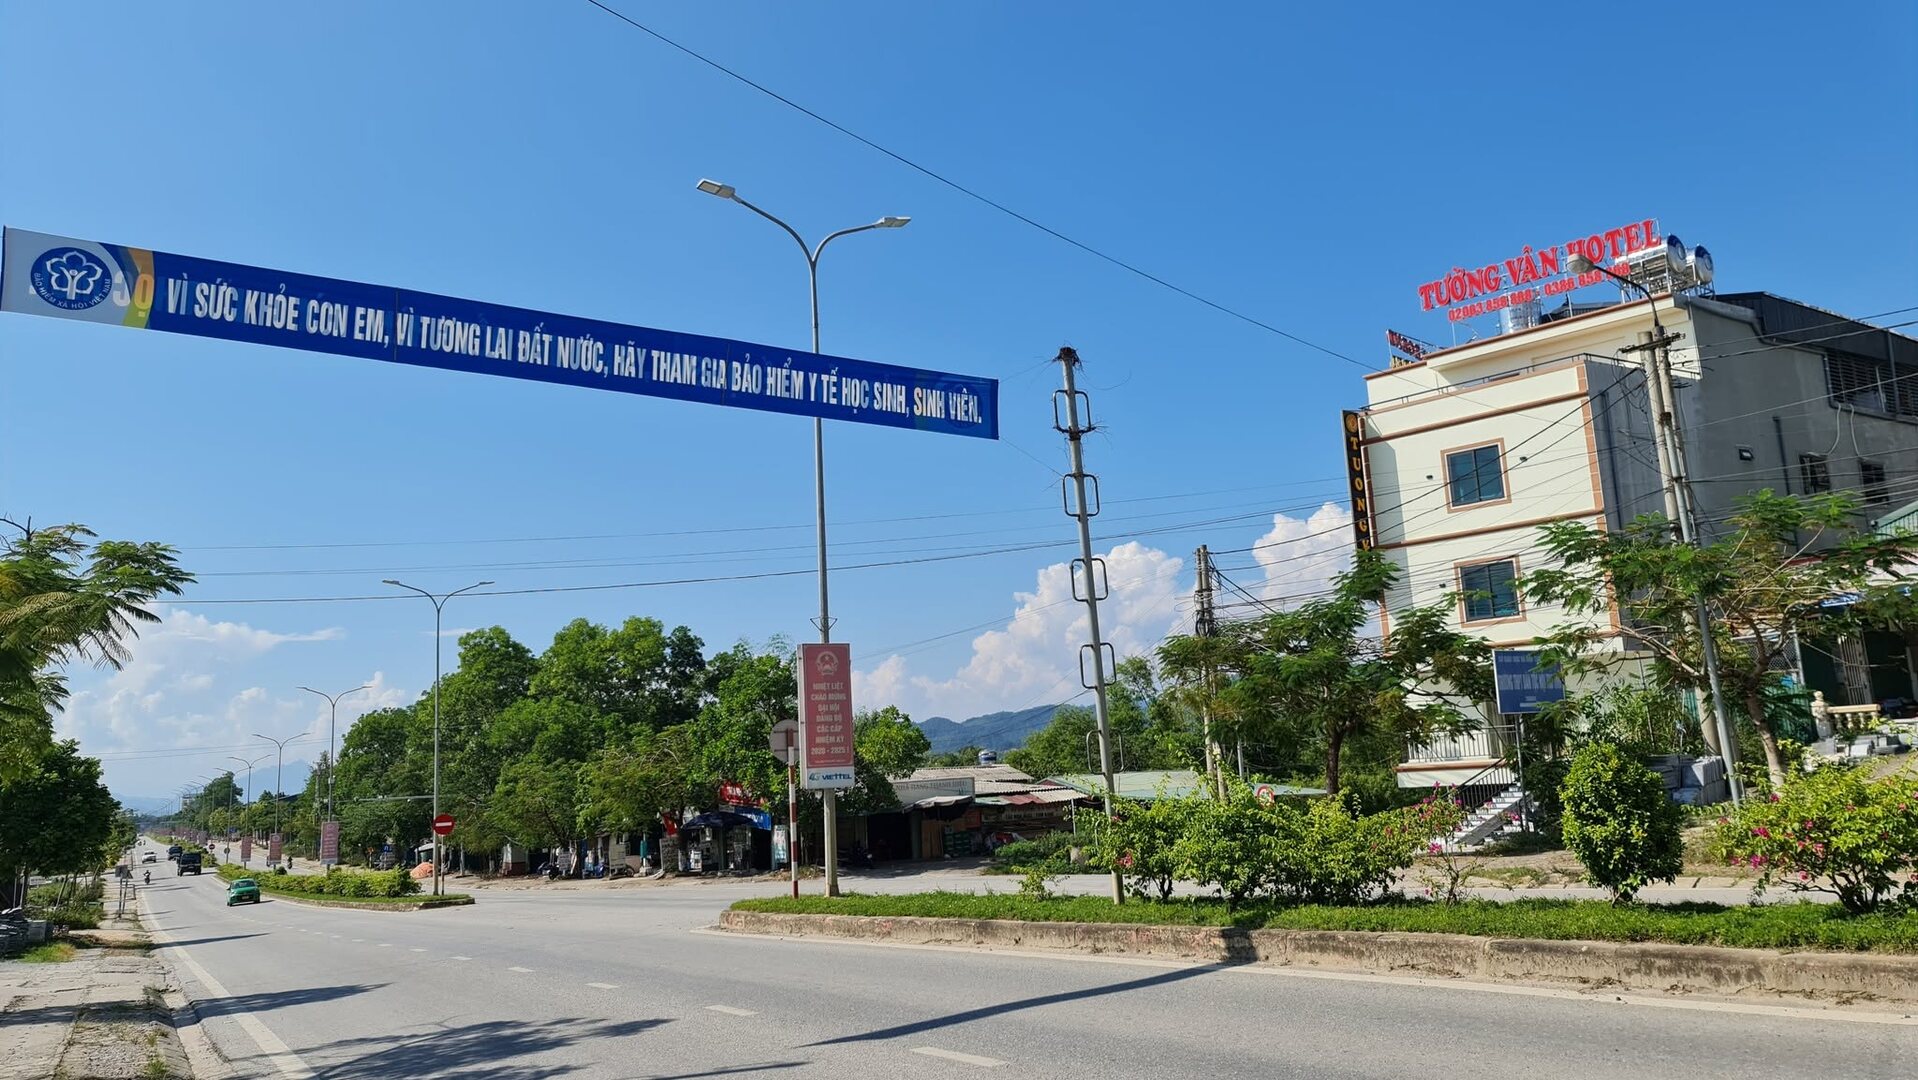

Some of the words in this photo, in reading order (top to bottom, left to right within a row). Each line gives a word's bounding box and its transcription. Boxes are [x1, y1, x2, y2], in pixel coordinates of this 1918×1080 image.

[1419, 265, 1500, 311] TƯỜNG
[1504, 244, 1560, 286] VÂN
[1566, 218, 1661, 264] HOTEL
[168, 273, 188, 315] VÌ
[194, 278, 238, 322] SỨC
[244, 283, 300, 331] KHỎE
[306, 299, 349, 338] CON
[353, 306, 389, 348] EM,
[396, 307, 414, 347] VÌ
[420, 315, 481, 356] TƯƠNG
[485, 326, 514, 361] LAI
[518, 322, 553, 365] ĐẤT
[556, 333, 609, 378] NƯỚC,
[613, 340, 647, 379] HÃY
[651, 349, 697, 386] THAM
[701, 357, 727, 389] GIA
[731, 353, 762, 394] BẢO
[766, 357, 804, 400] HIỂM
[808, 372, 818, 401] Y
[821, 367, 839, 404] TẾ
[842, 377, 869, 414] HỌC
[873, 381, 910, 418] SINH,
[913, 387, 945, 419] SINH
[948, 387, 982, 424] VIÊN.
